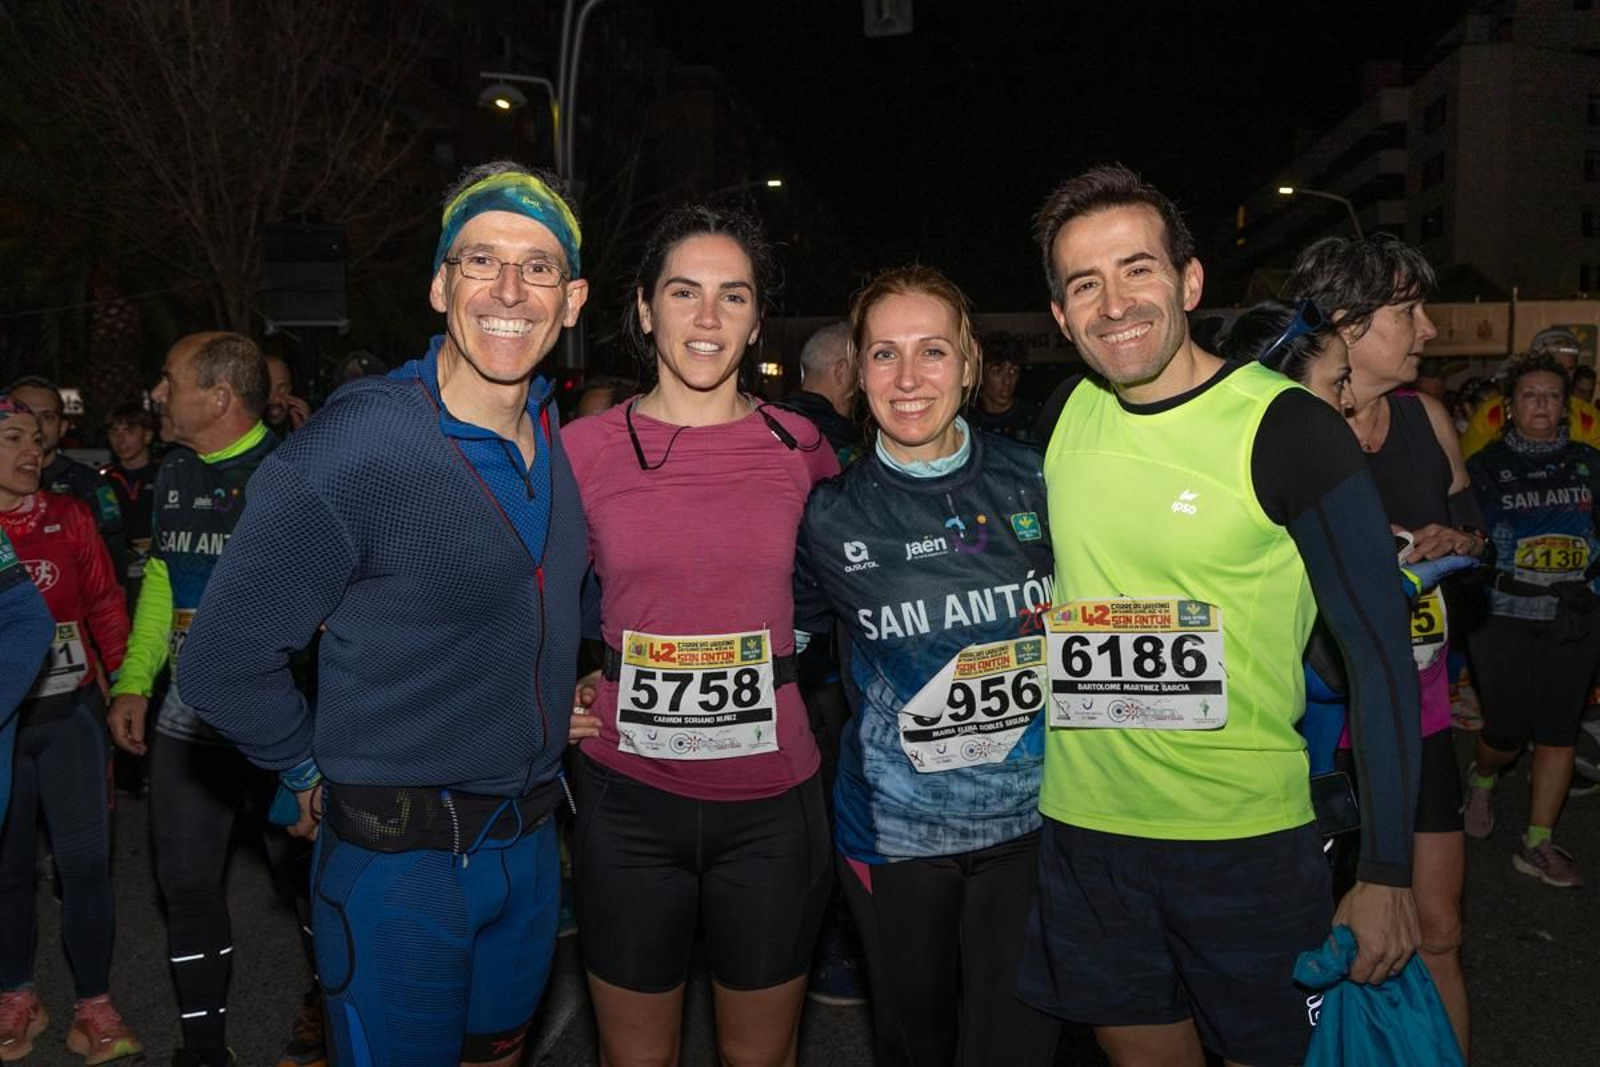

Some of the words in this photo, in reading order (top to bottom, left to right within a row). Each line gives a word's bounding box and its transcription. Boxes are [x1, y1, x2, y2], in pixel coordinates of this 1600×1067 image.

[1501, 490, 1540, 510] SAN
[160, 531, 192, 552] SAN
[857, 599, 931, 641] SAN
[1081, 605, 1111, 626] 42
[1111, 615, 1133, 625] SAN
[648, 642, 676, 663] 42
[678, 652, 699, 663] SAN
[1060, 633, 1208, 679] 6186
[630, 668, 762, 712] 5758
[912, 669, 1042, 727] 956
